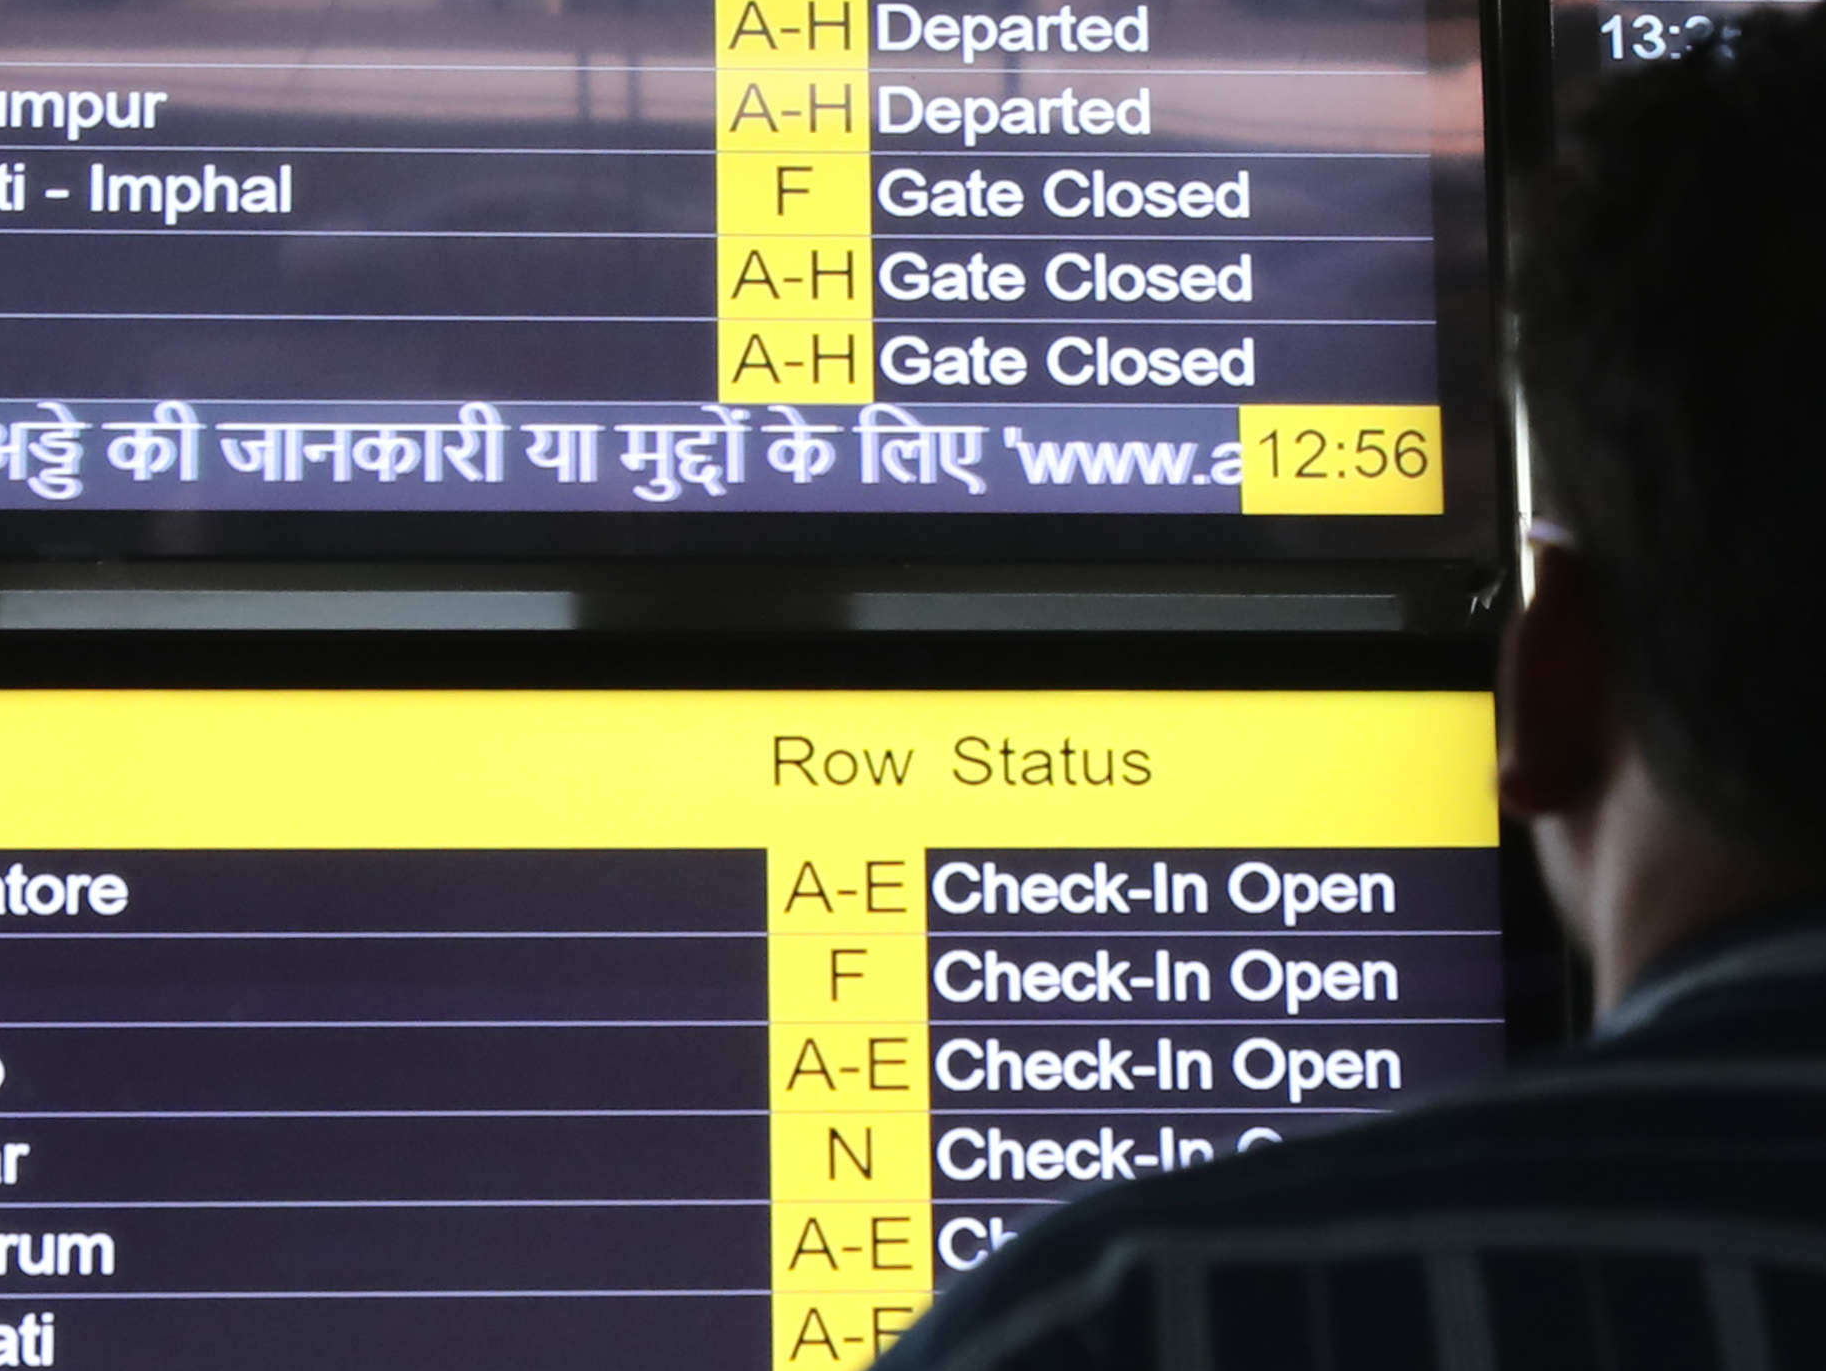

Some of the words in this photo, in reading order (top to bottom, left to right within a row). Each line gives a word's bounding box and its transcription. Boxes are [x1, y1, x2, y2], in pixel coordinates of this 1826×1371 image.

[45, 189, 69, 198] -
[91, 164, 291, 225] Imphal
[777, 166, 812, 216] F
[878, 168, 1024, 216] Gate
[1044, 169, 1249, 218] Closed
[102, 402, 206, 483] की
[217, 402, 511, 485] जानकारी
[1260, 429, 1428, 479] 12:56
[774, 736, 914, 786] Row
[953, 736, 1151, 786] Status
[784, 861, 907, 913] A-E
[932, 862, 1208, 913] Check-In
[1228, 862, 1395, 926] Open
[829, 1127, 872, 1180] N
